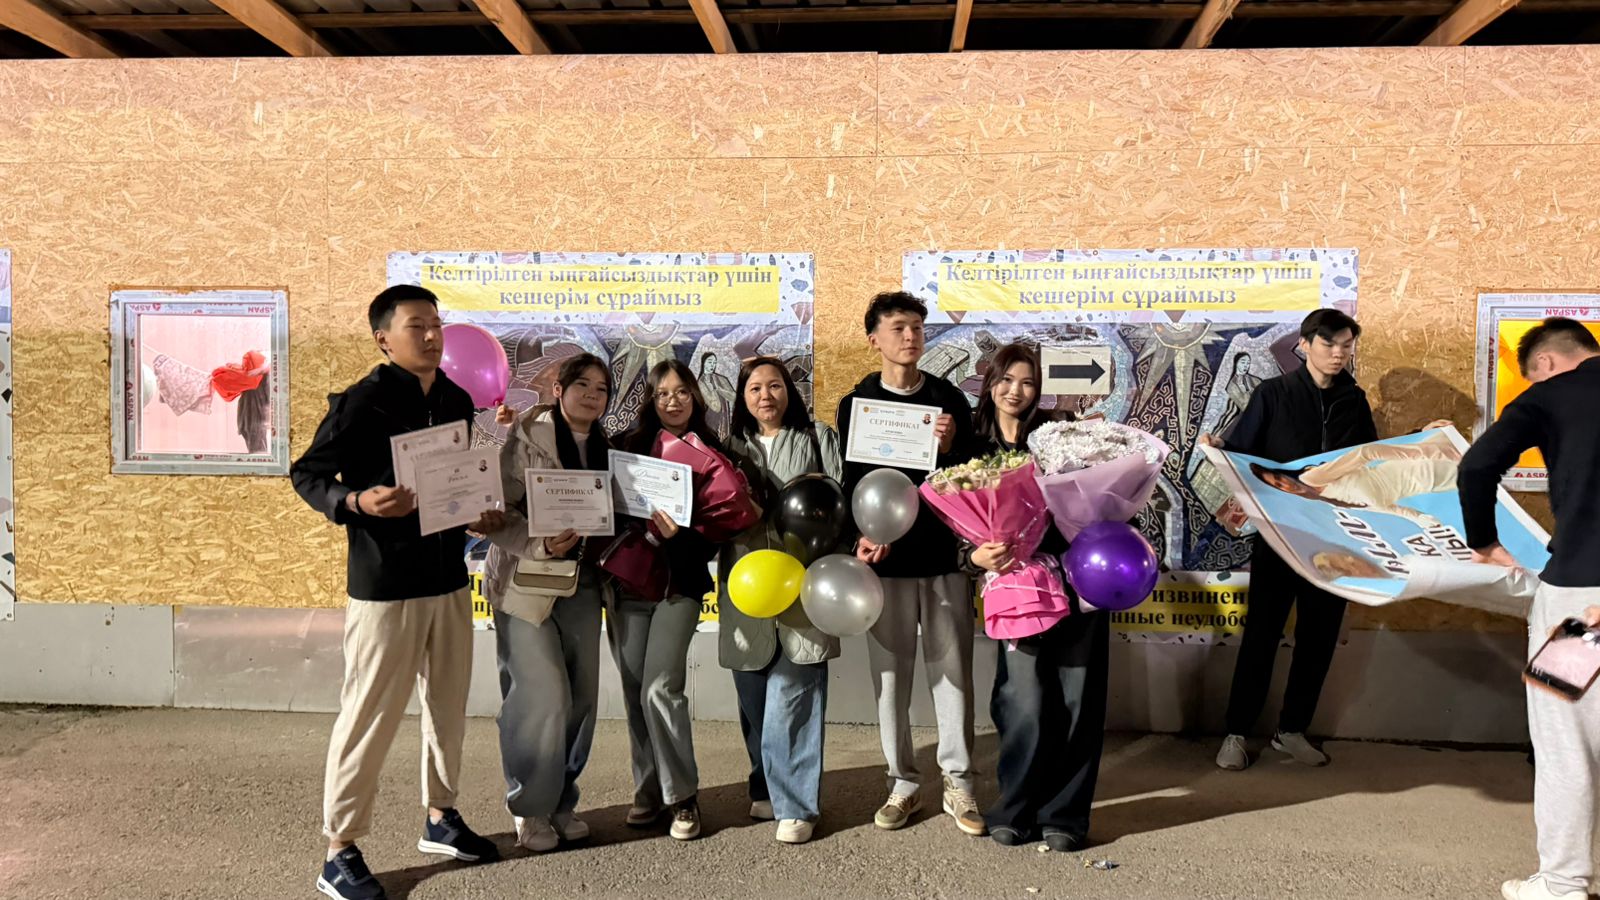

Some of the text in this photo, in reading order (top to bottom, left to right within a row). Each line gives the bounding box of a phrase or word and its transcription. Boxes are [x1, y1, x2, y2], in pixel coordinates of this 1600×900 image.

[429, 264, 772, 285] Келтірілген ыңғайсыздықтар үшін
[946, 263, 1313, 284] Келтірілген ыңғайсыздықтар үшін
[499, 290, 702, 309] кешерім сұраймыз
[1018, 288, 1236, 308] кешерім сұраймыз
[1545, 308, 1577, 316] ASPAN
[869, 418, 920, 430] СЕРТИФИКАТ
[545, 488, 594, 496] СЕРТИФИКАТ
[1152, 590, 1248, 605] извинен
[1171, 611, 1248, 630] неудобс
